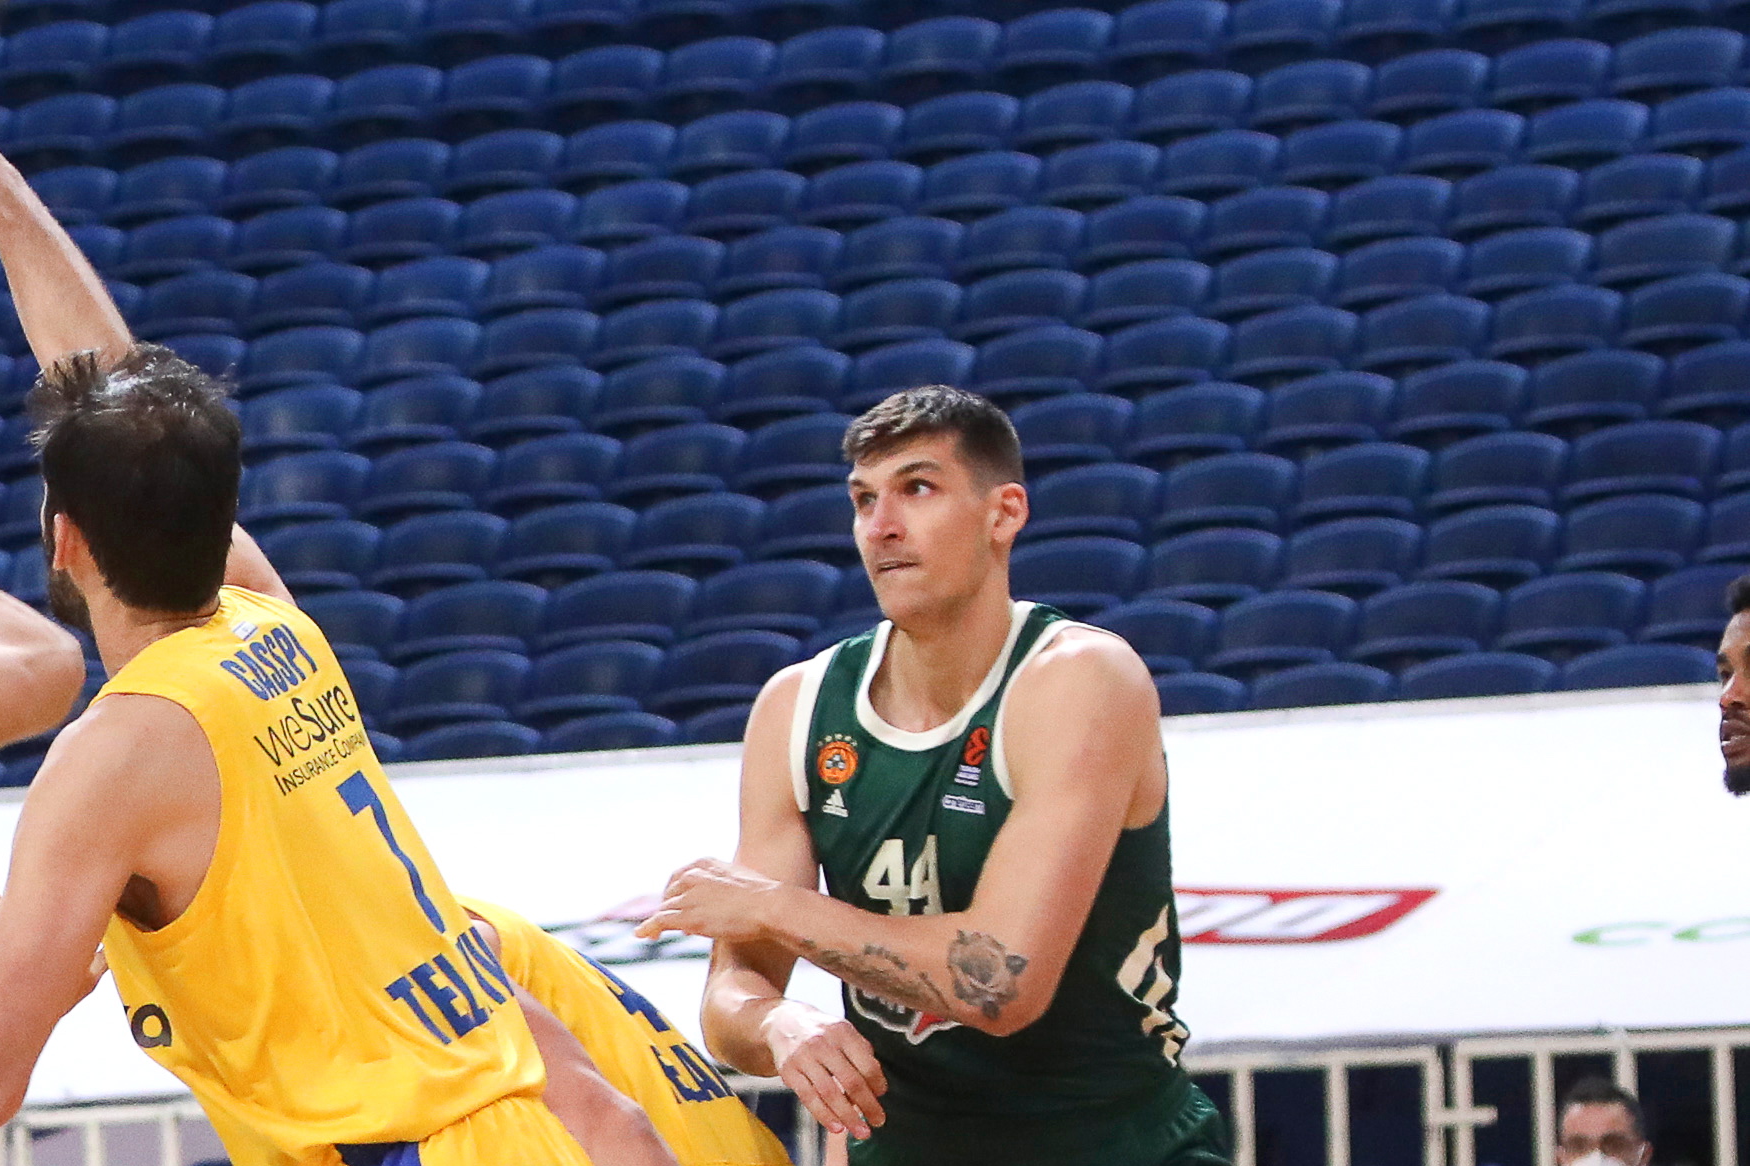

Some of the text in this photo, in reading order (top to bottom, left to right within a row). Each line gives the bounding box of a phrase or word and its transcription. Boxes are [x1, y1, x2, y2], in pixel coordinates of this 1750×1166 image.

[220, 623, 318, 701] CASSPI
[336, 769, 447, 934] 7
[862, 833, 944, 916] 44
